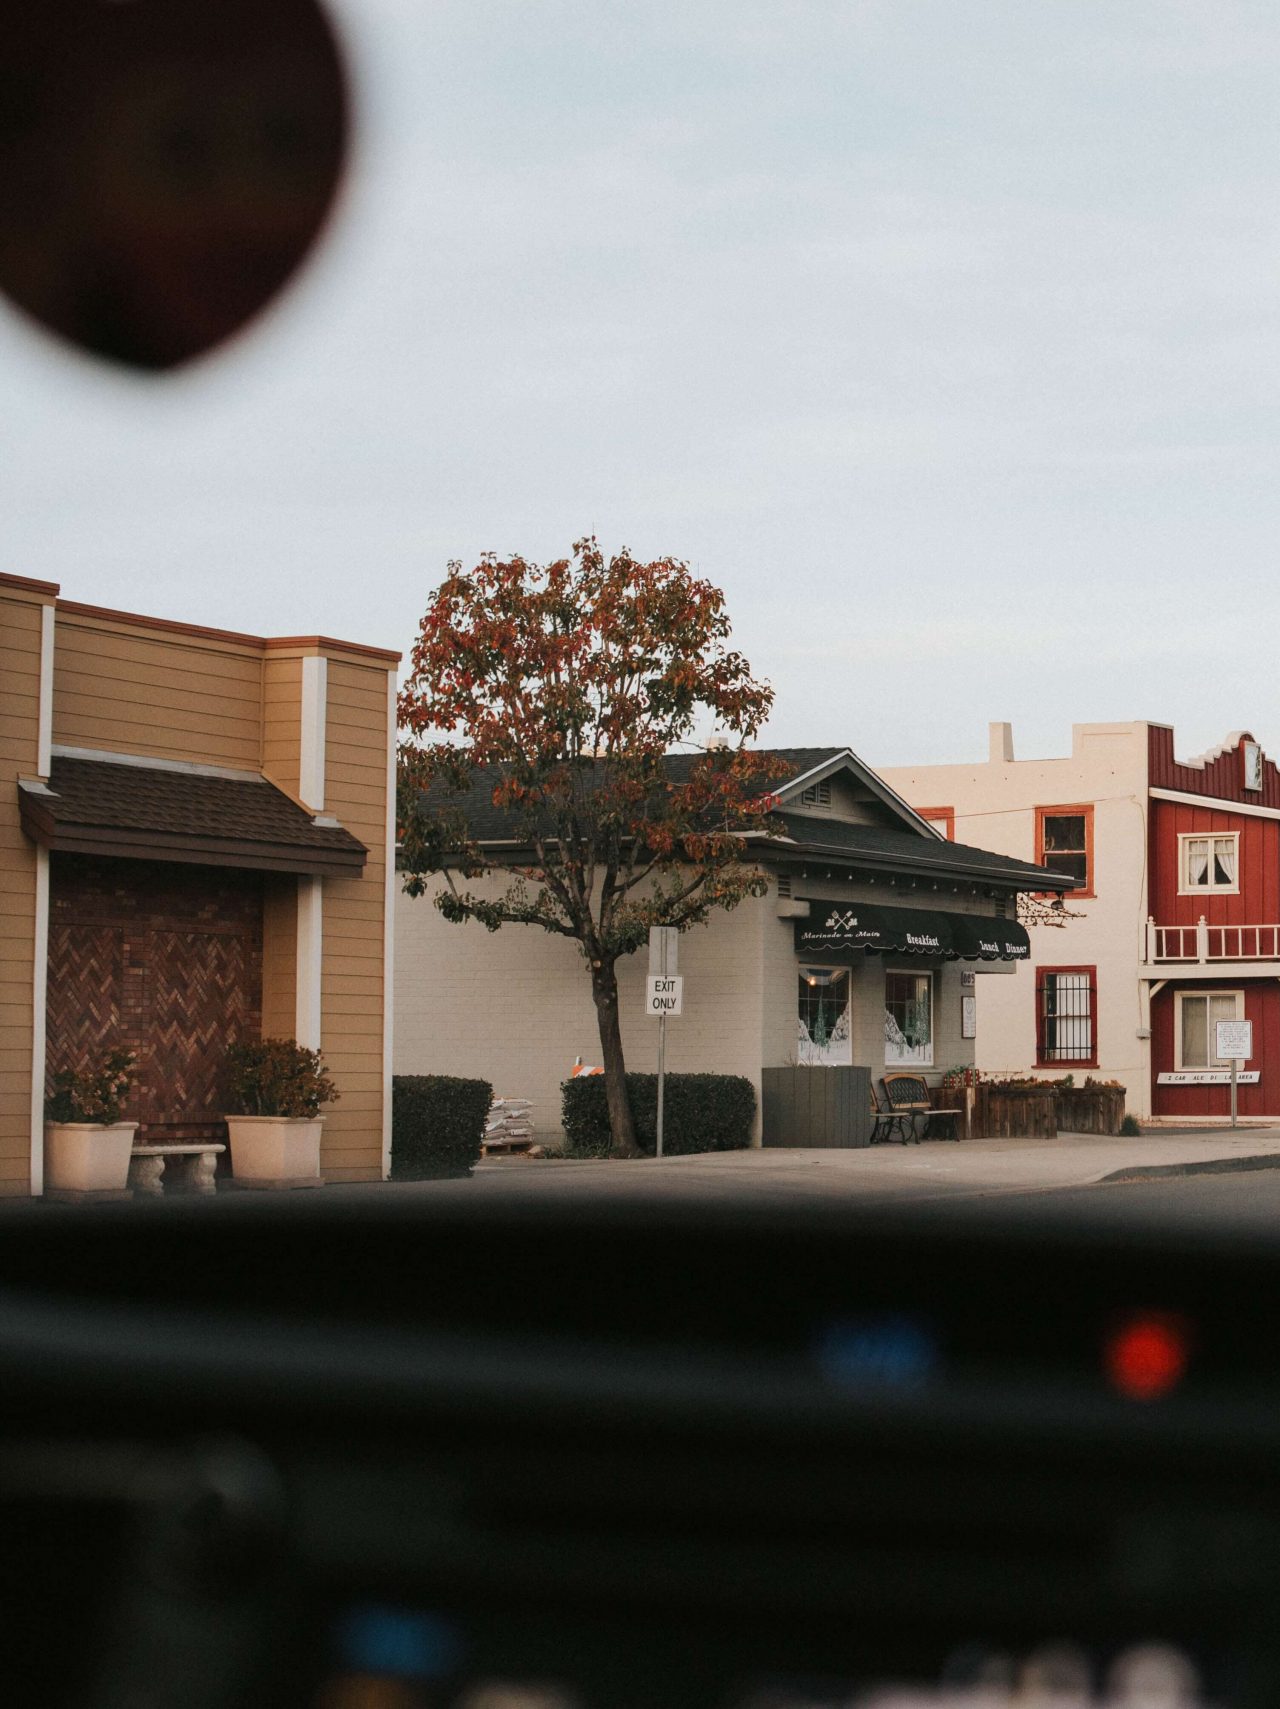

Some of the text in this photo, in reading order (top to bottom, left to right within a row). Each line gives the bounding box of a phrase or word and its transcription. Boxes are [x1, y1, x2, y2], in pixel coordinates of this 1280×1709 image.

[906, 933, 939, 946] Breakfast
[980, 941, 1027, 954] Lunch Dinner
[655, 980, 676, 992] EXIT
[652, 997, 677, 1009] ONLY
